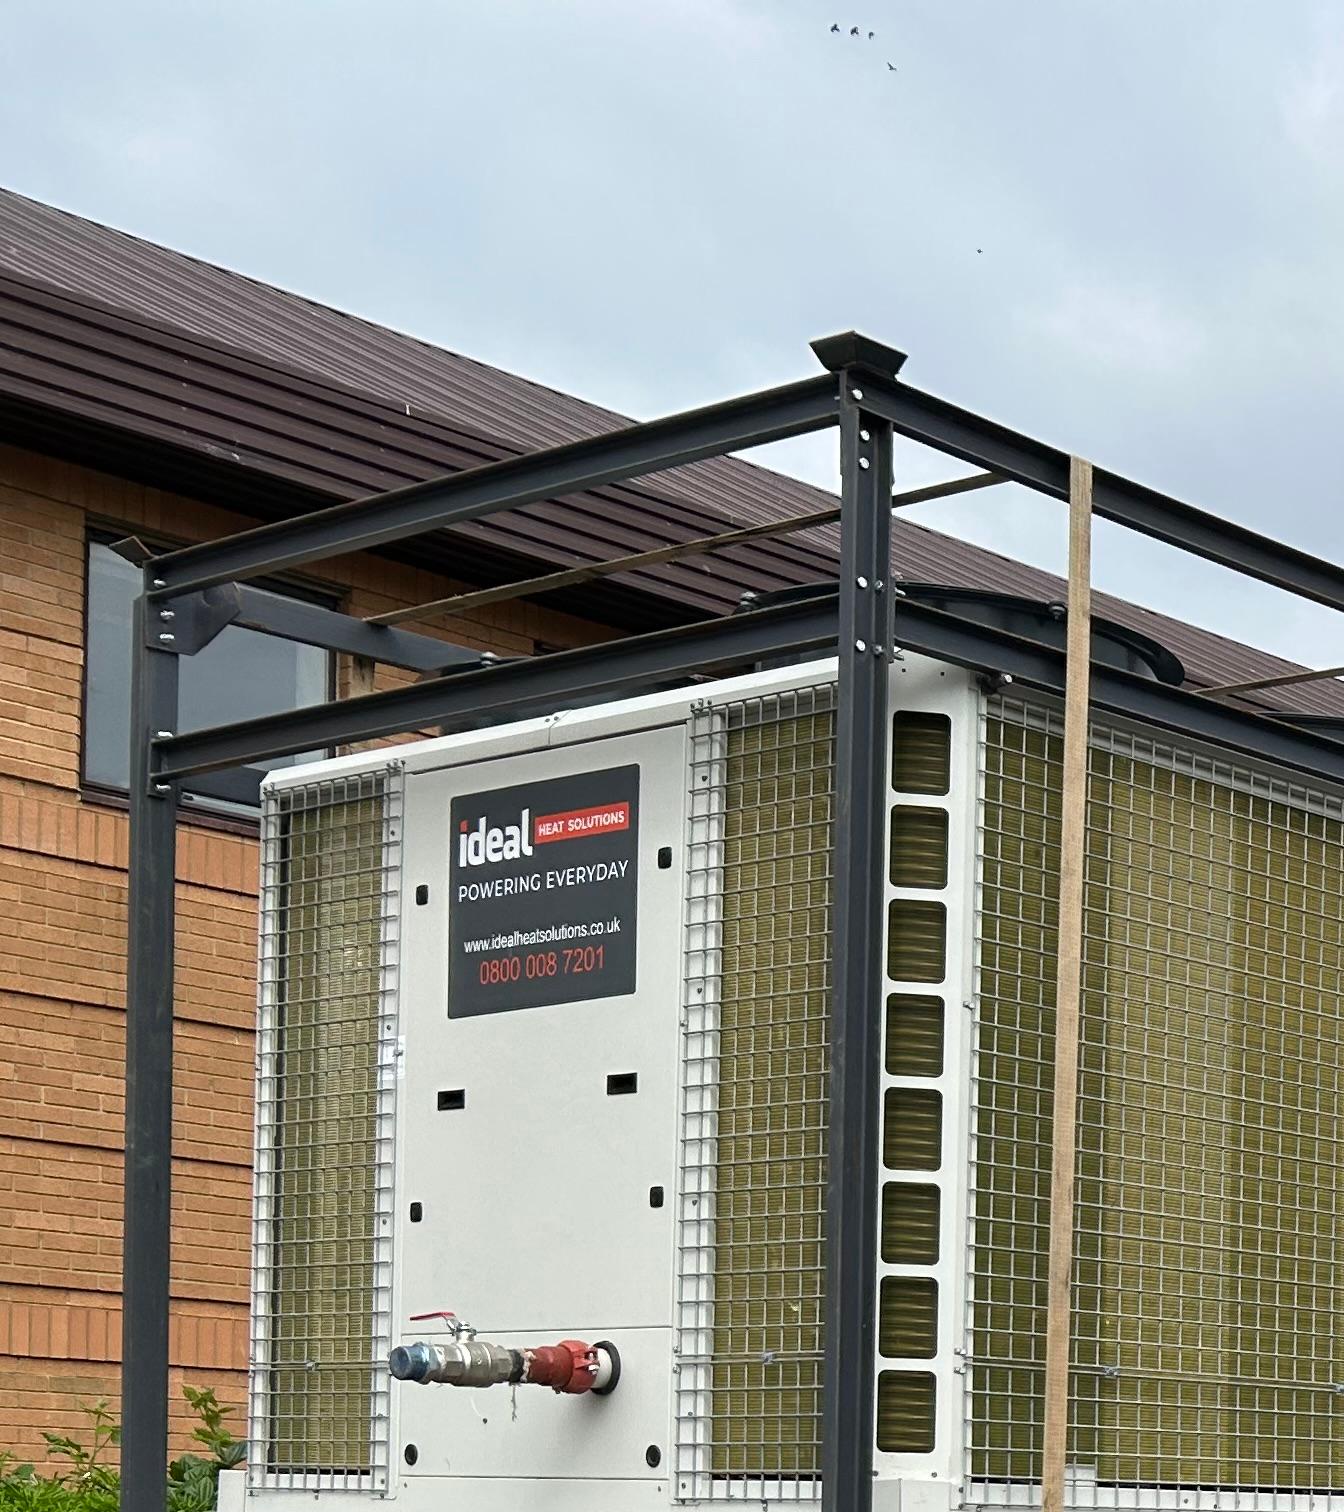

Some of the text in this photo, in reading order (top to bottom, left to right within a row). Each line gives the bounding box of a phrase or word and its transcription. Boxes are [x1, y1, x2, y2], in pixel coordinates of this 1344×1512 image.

[459, 808, 625, 868] ideal HEAT SOLUTIONS
[458, 860, 629, 902] POWERING EVERYDAY
[464, 916, 621, 954] www.idealheatsolutions.co.uk
[480, 945, 605, 985] 0800 008 7201
